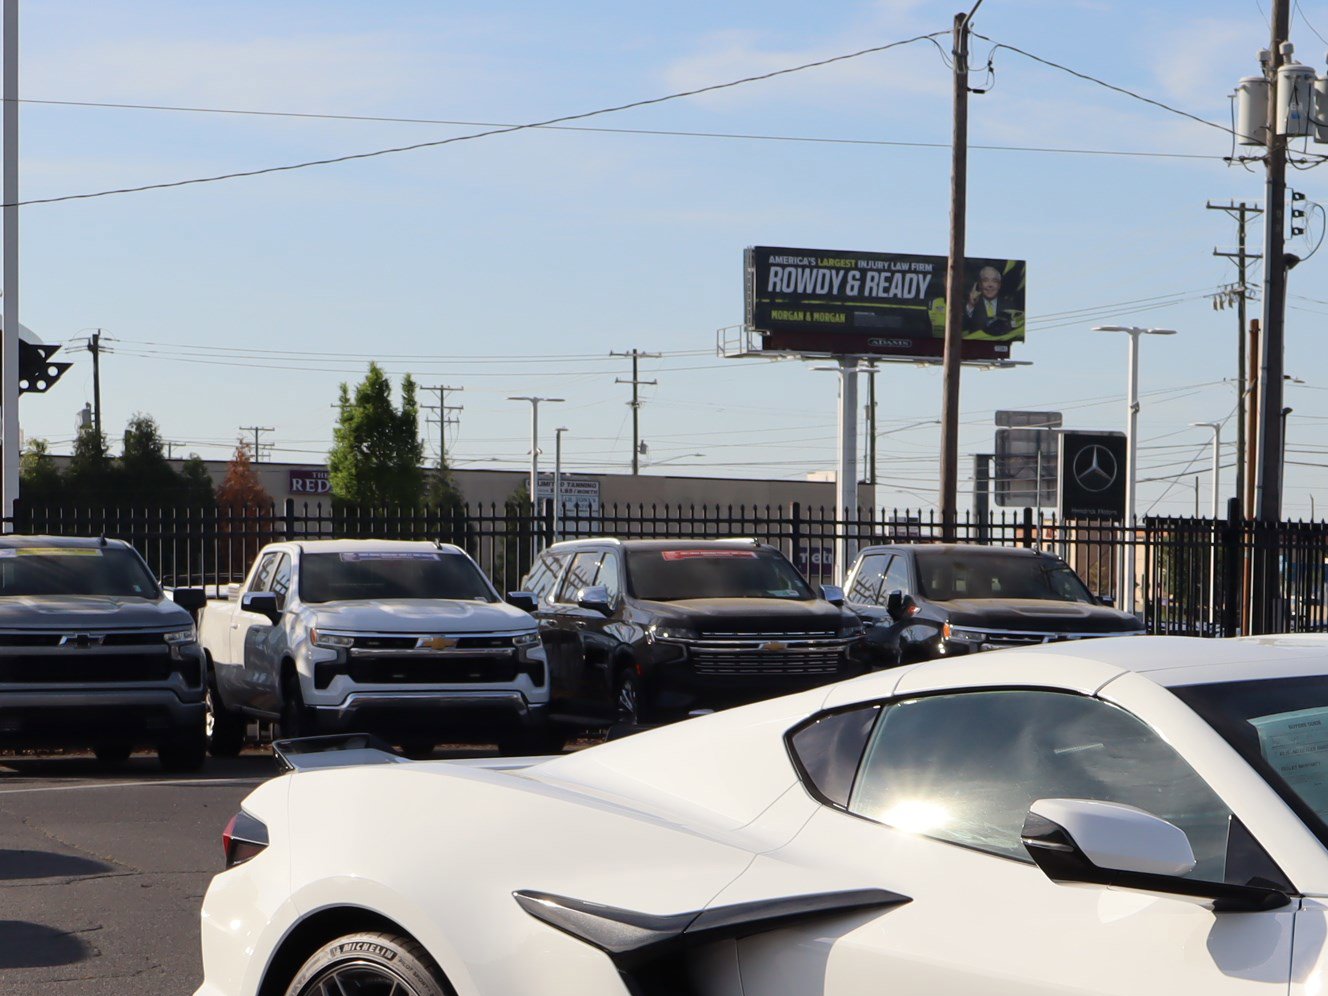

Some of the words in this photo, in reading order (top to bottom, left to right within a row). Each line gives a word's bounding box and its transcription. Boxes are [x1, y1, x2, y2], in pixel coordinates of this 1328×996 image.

[768, 256, 815, 265] AMERICA'S
[818, 258, 856, 268] LARGEST
[858, 260, 889, 270] INJURY
[891, 262, 909, 271] LAW
[911, 263, 933, 272] FIRM
[768, 266, 844, 296] ROWDY
[845, 270, 861, 297] &
[864, 271, 932, 300] READY
[771, 310, 804, 322] MORGAN
[806, 312, 811, 322] &
[813, 312, 846, 323] MORGAN
[292, 478, 331, 493] RED
[342, 942, 395, 959] MICHELIN
